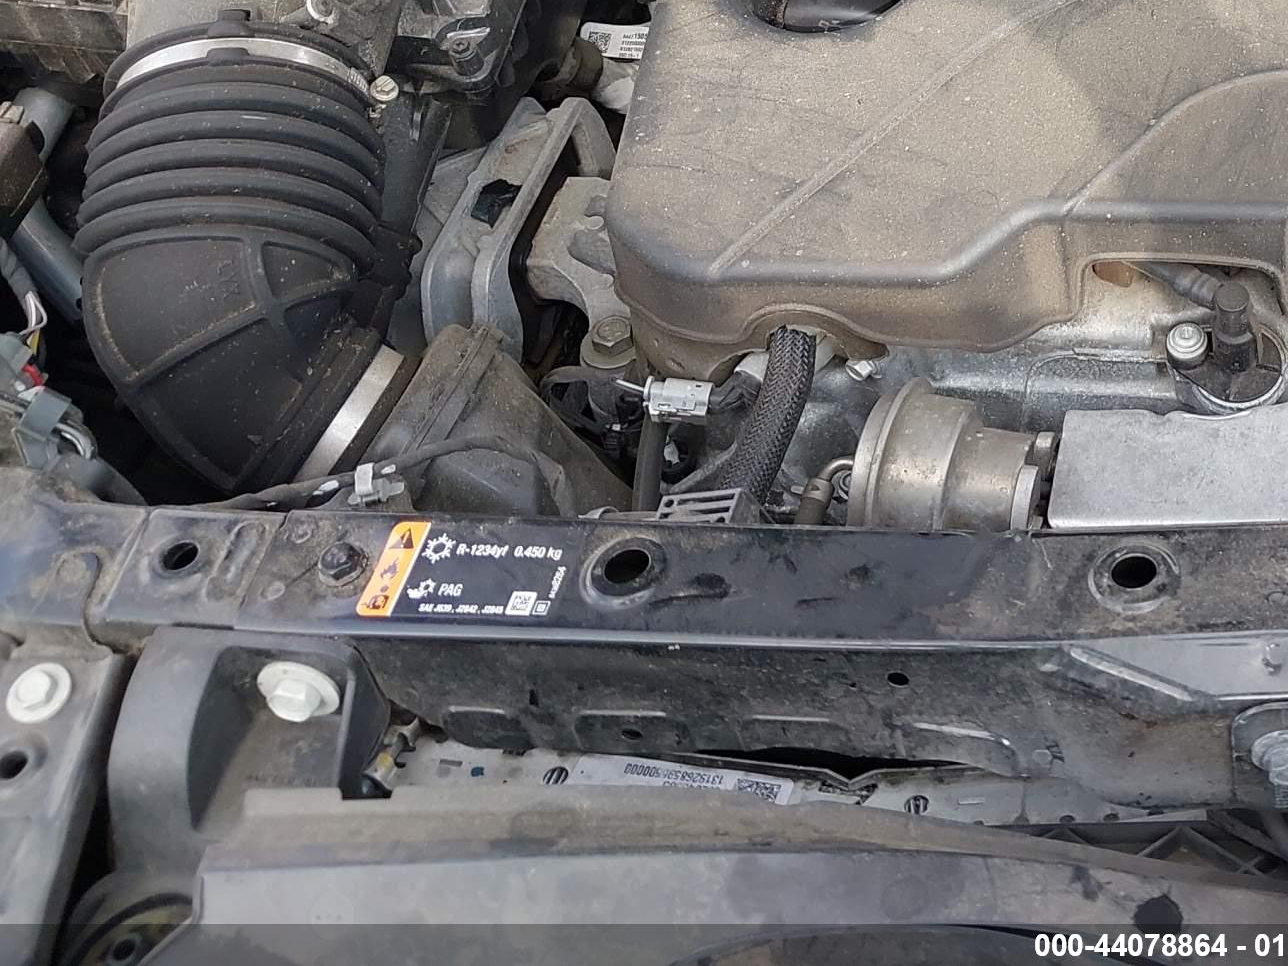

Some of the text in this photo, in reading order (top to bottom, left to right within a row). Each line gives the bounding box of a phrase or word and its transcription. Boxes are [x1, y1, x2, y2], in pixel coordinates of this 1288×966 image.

[456, 543, 563, 561] R-1234yf 0.450 kg
[438, 583, 464, 597] PAG
